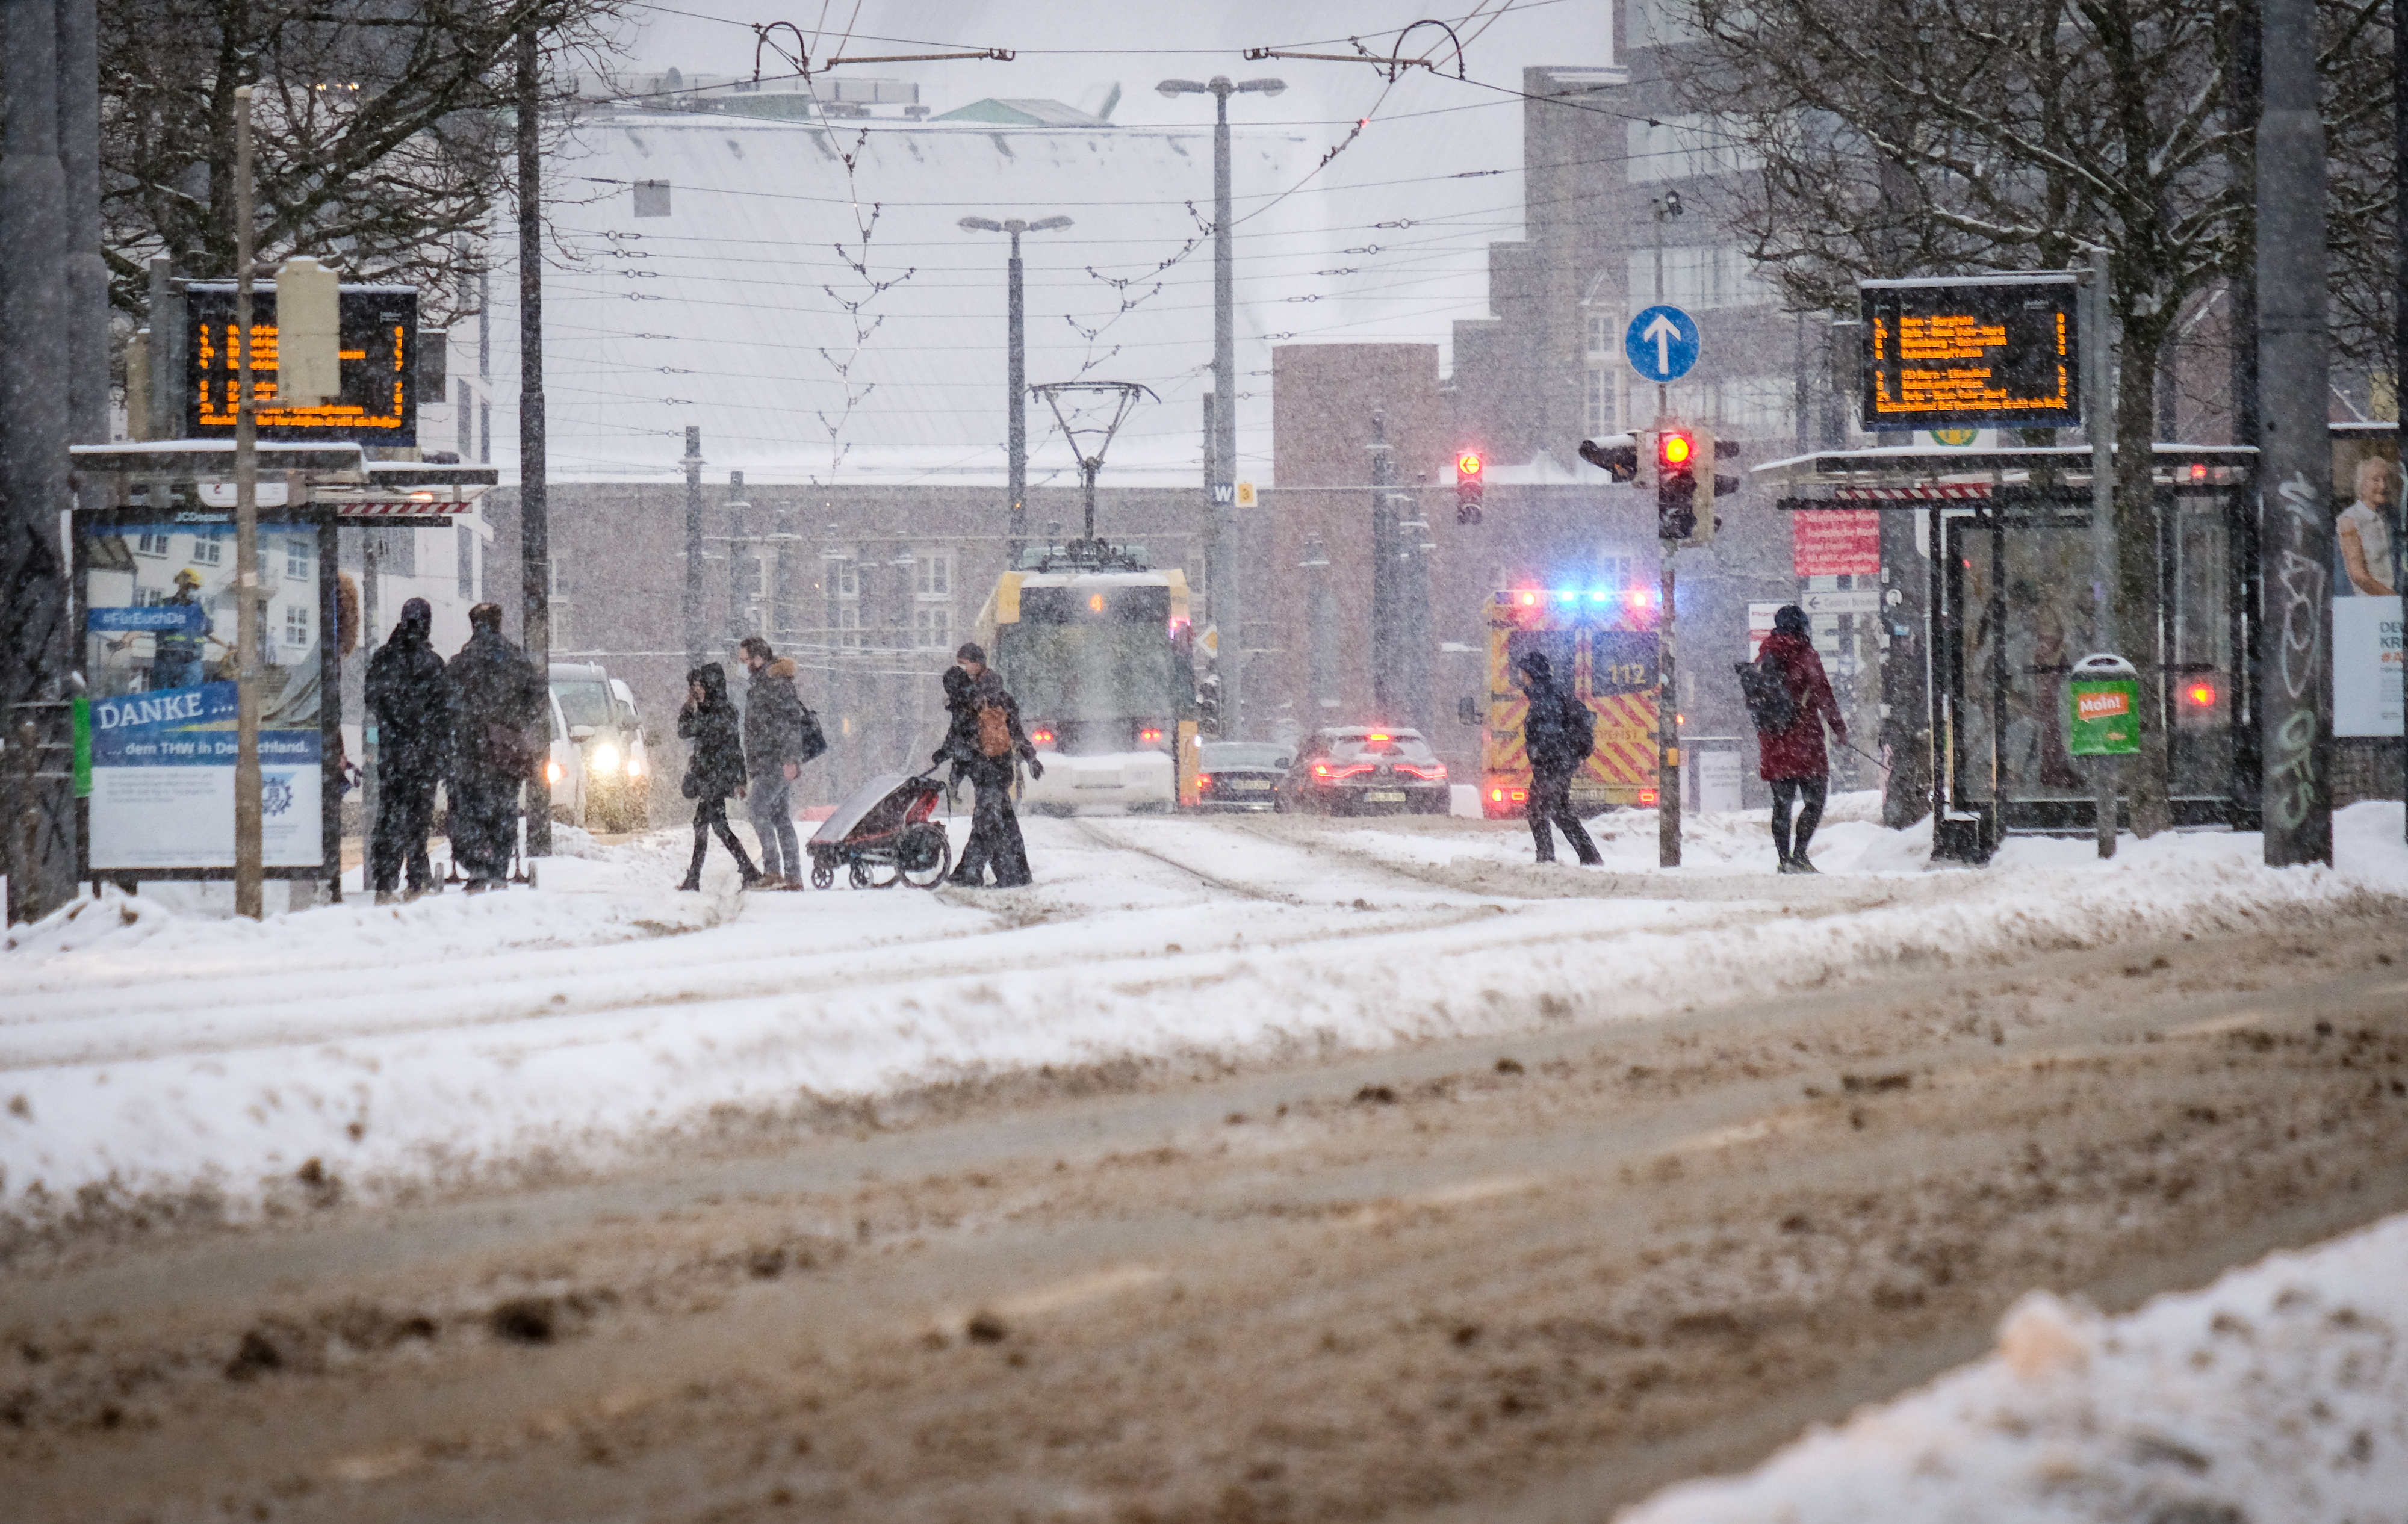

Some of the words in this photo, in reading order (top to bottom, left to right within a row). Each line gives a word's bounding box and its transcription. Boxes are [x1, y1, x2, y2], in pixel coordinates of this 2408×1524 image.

[1215, 486, 1232, 501] W
[1609, 664, 1646, 684] 112
[98, 692, 203, 730] DANKE
[2080, 695, 2121, 713] Moin!
[125, 742, 157, 755] dem
[160, 742, 194, 755] THW
